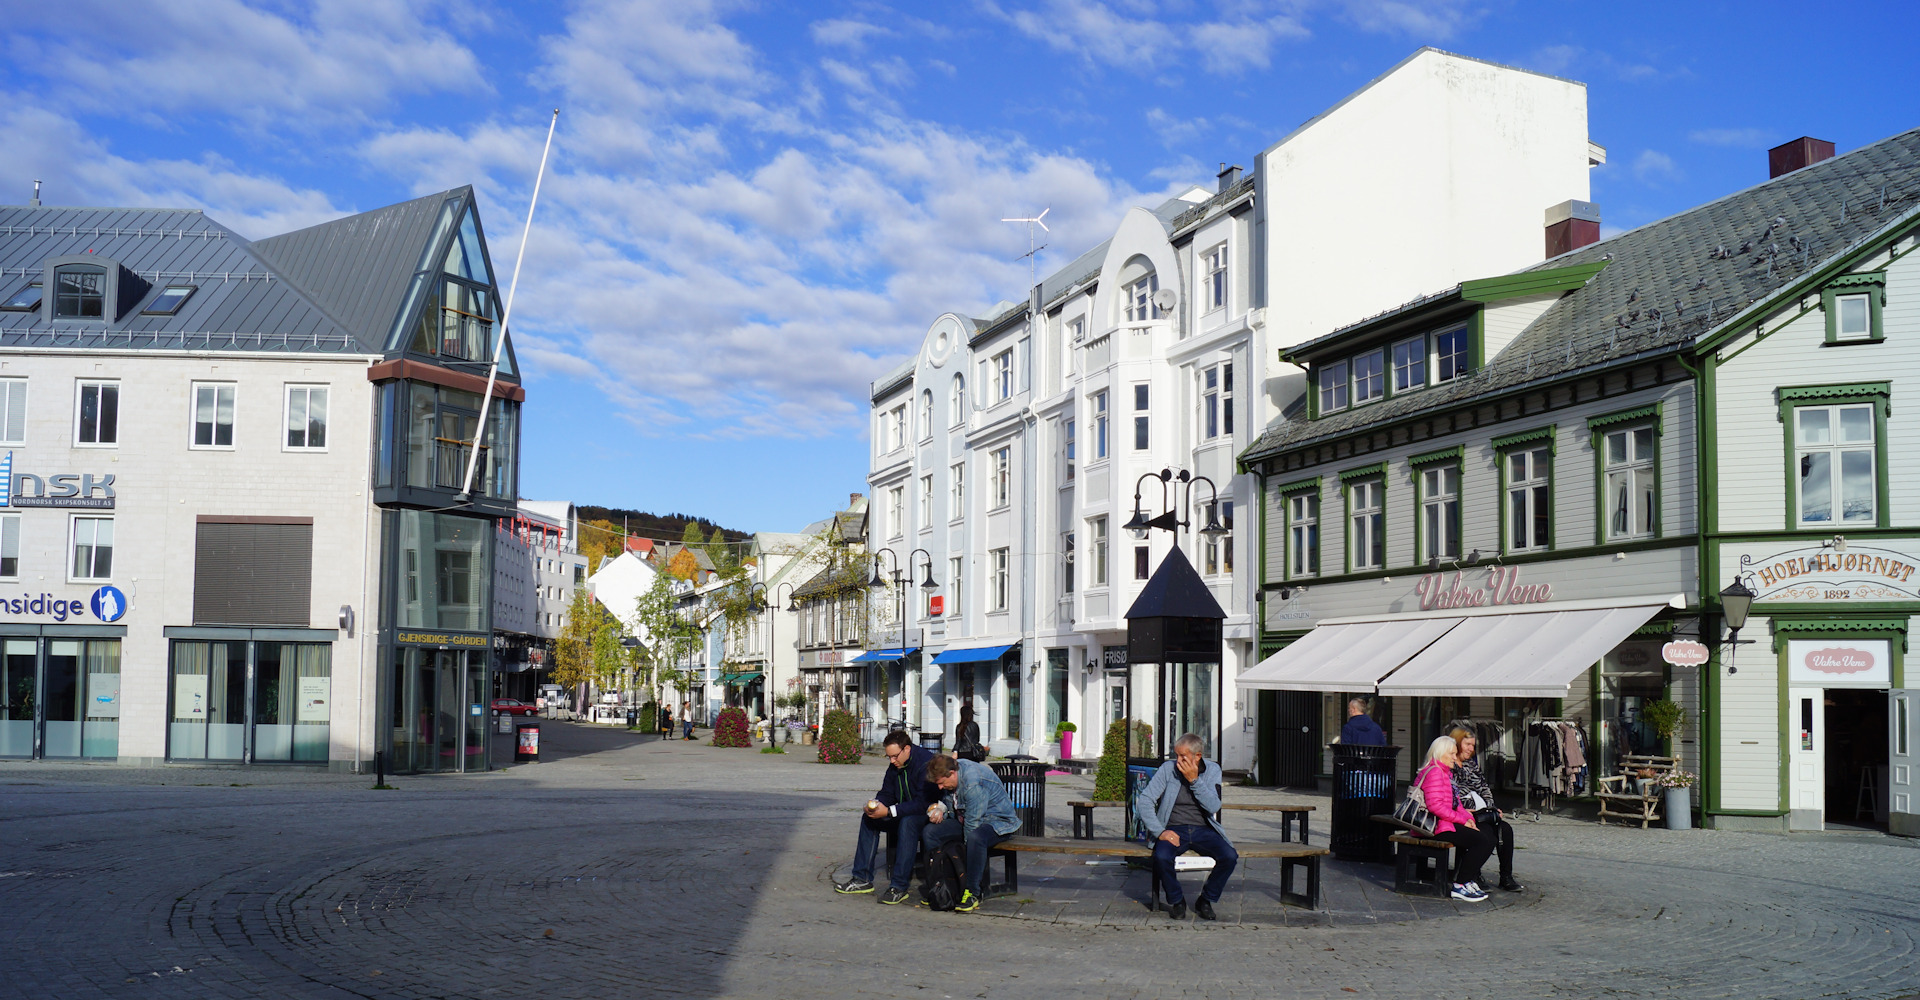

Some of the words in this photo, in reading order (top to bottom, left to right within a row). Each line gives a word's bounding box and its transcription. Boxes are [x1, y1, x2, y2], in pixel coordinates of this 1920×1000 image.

[13, 498, 53, 506] NORDNORSK
[1417, 570, 1488, 610] Vakre
[1487, 565, 1554, 606] Vene
[1823, 590, 1851, 600] 1892
[398, 632, 488, 646] GJENSIDIGE-GÅRDEN
[1668, 648, 1688, 659] Vakre
[1687, 648, 1703, 659] Vene
[1812, 655, 1842, 667] Vakre
[1841, 655, 1866, 667] Vene
